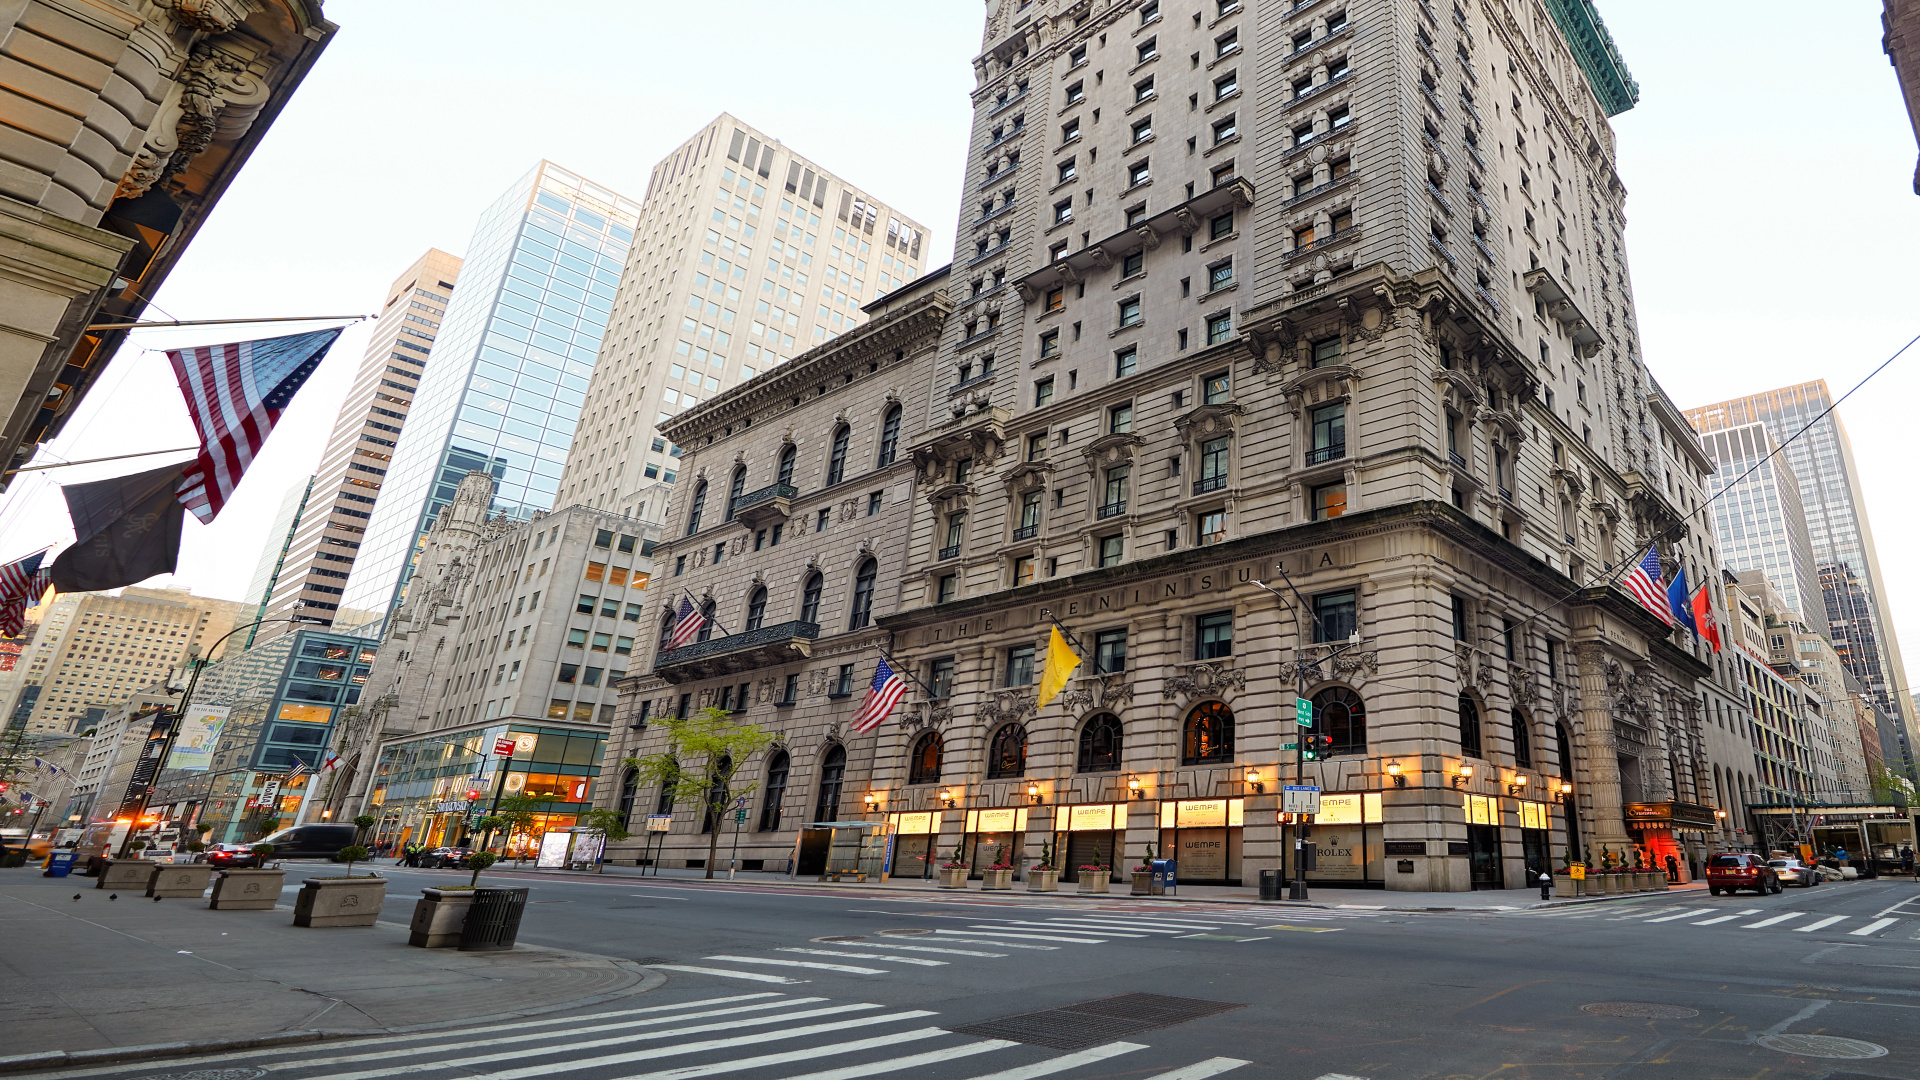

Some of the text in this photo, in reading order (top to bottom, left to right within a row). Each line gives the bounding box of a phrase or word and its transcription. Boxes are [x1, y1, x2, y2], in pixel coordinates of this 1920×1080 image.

[934, 552, 1334, 641] THE PENINSULA
[1610, 630, 1636, 649] PENINSULA
[261, 782, 278, 803] MoMA
[1185, 841, 1221, 849] WEMPE
[1316, 848, 1352, 857] ROLEX
